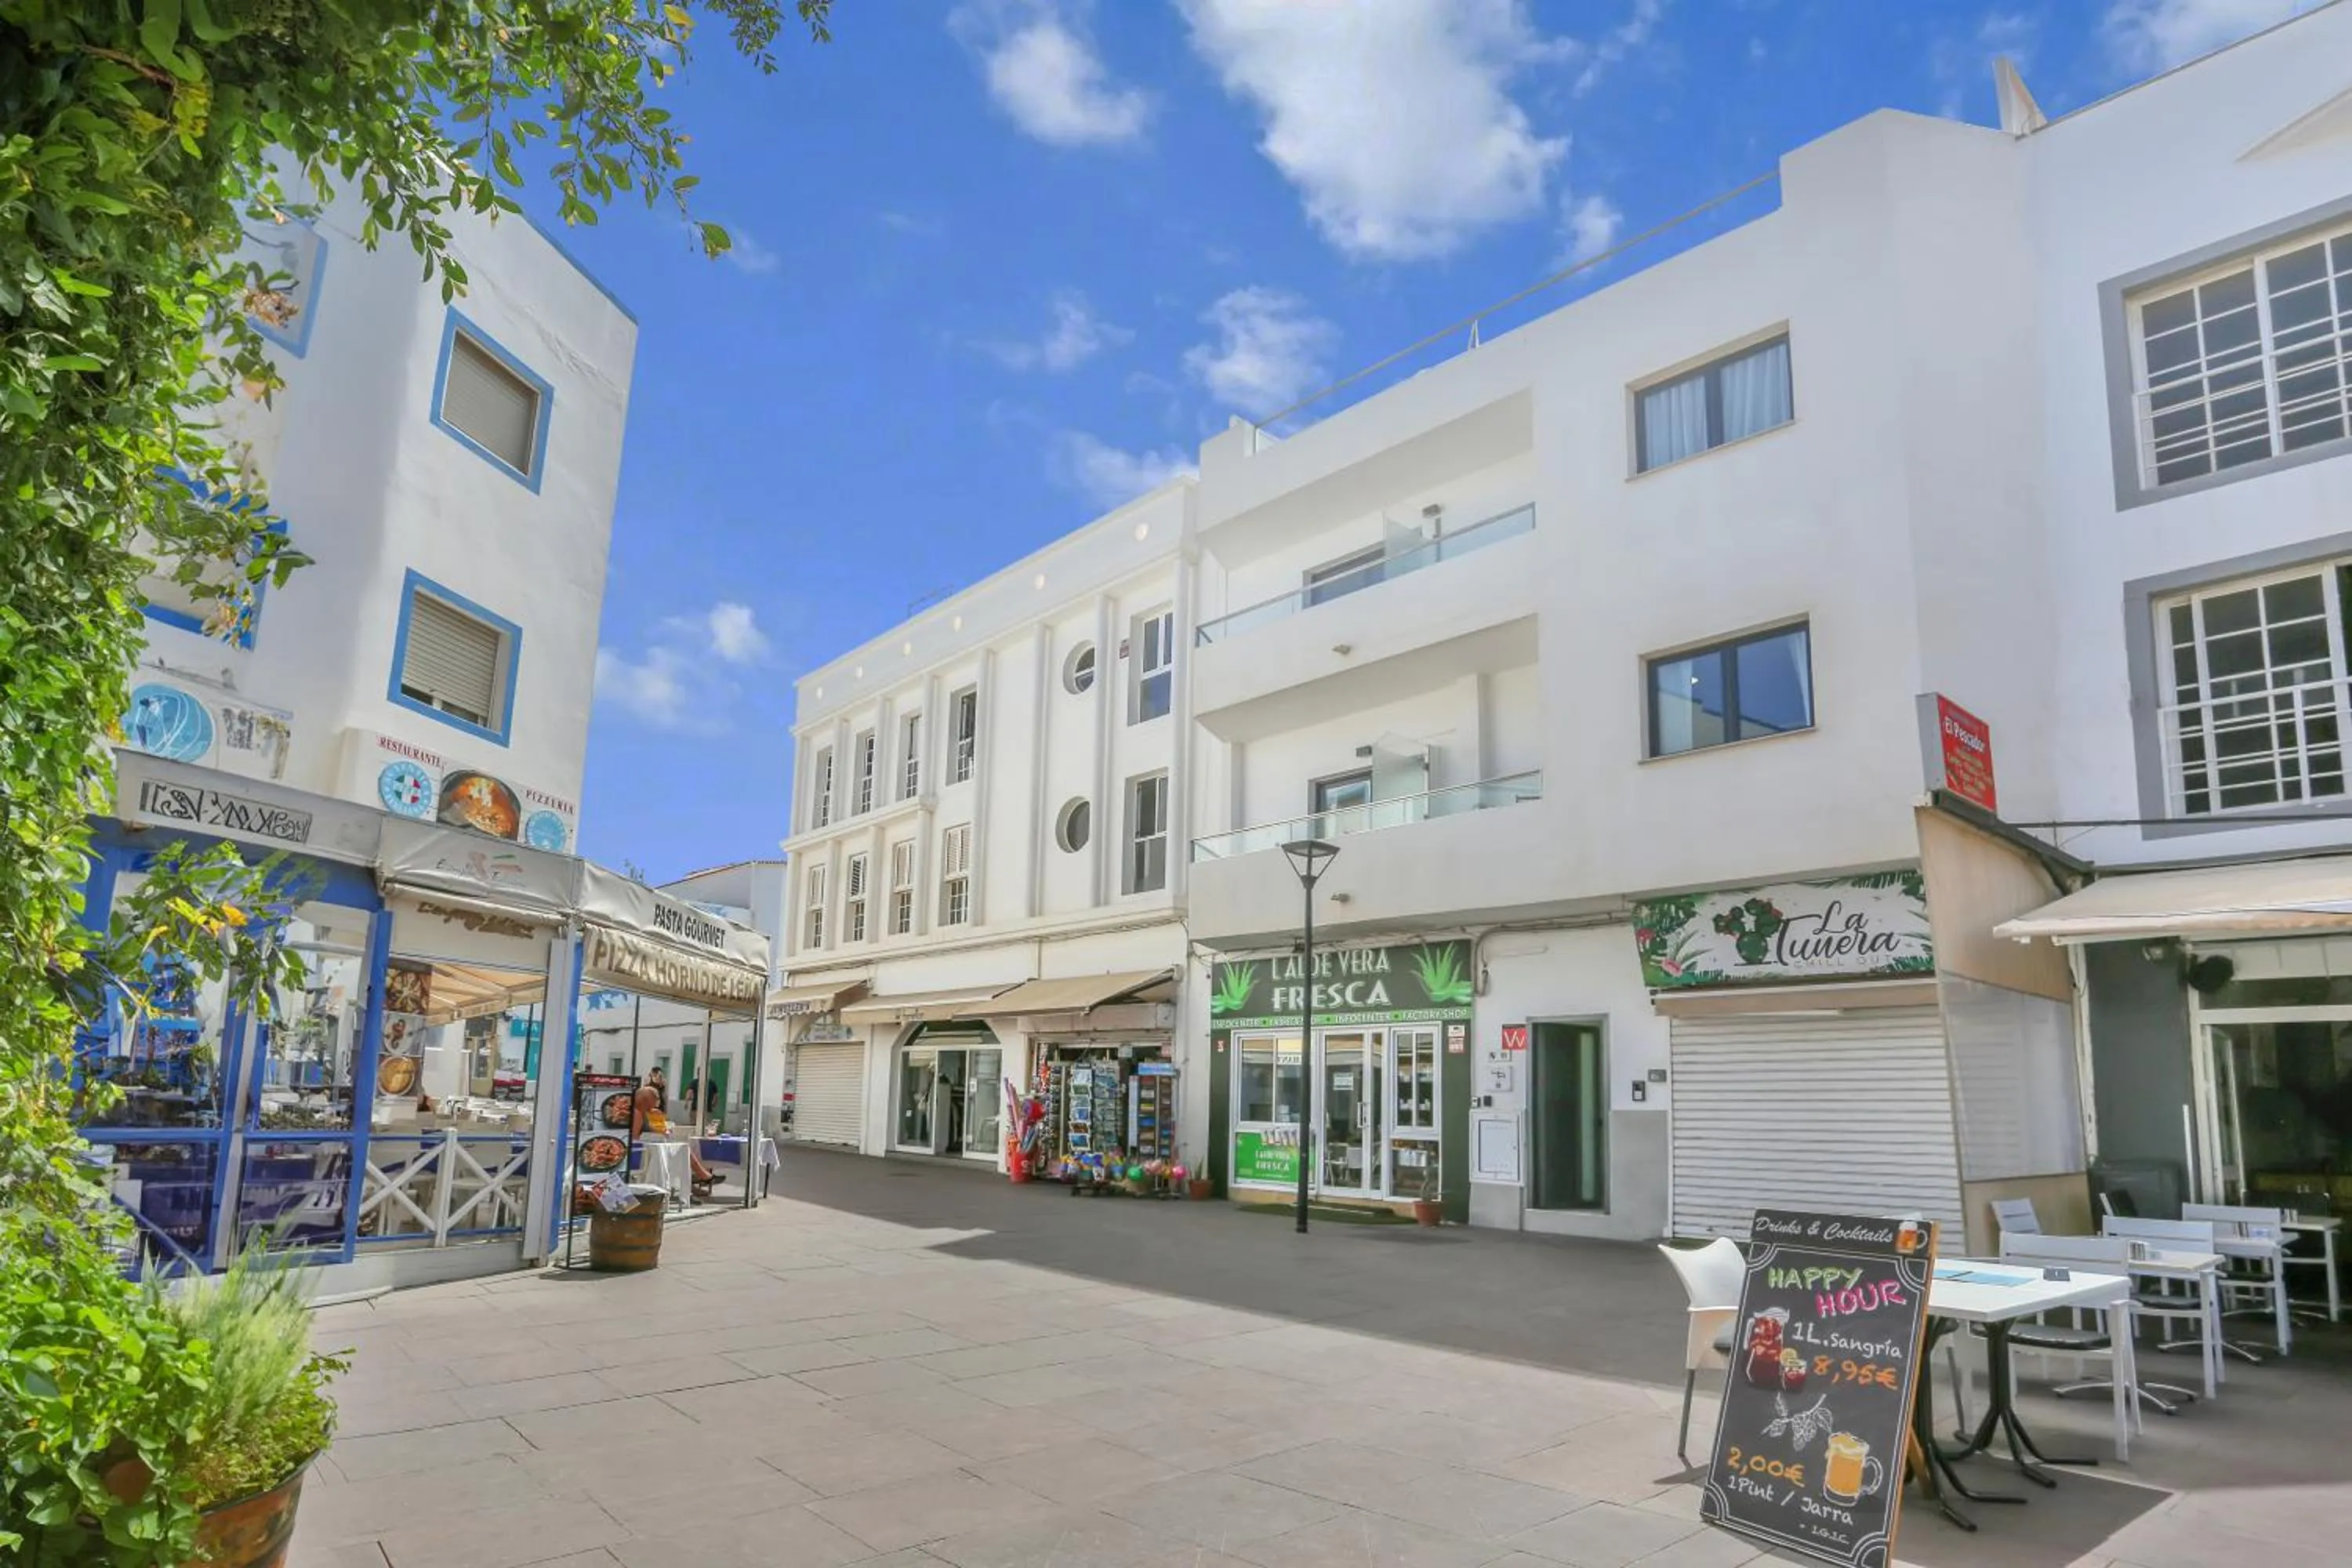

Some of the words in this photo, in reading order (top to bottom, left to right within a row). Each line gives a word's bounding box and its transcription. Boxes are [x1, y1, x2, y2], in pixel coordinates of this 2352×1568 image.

[526, 789, 575, 815] PIZZERIA
[653, 903, 683, 935] PASTA
[684, 916, 726, 949] GOURMET
[1813, 900, 1868, 935] La
[1777, 913, 1900, 967] Tunera
[593, 938, 650, 981] PIZZA
[655, 958, 709, 995] HORNO
[1338, 948, 1391, 977] VERA
[1793, 956, 1844, 968] CHILL
[1856, 953, 1890, 965] OUT
[1271, 980, 1392, 1013] FRESCA
[1755, 1217, 1802, 1234] Drinks
[1807, 1221, 1820, 1236] &
[1823, 1222, 1893, 1243] Cocktails
[1767, 1266, 1864, 1290] HAPPY
[1814, 1279, 1907, 1319] HOUR
[1813, 1355, 1898, 1391] 8,95€
[1727, 1446, 1805, 1487] 2,00€
[1801, 1497, 1853, 1526] Jarra
